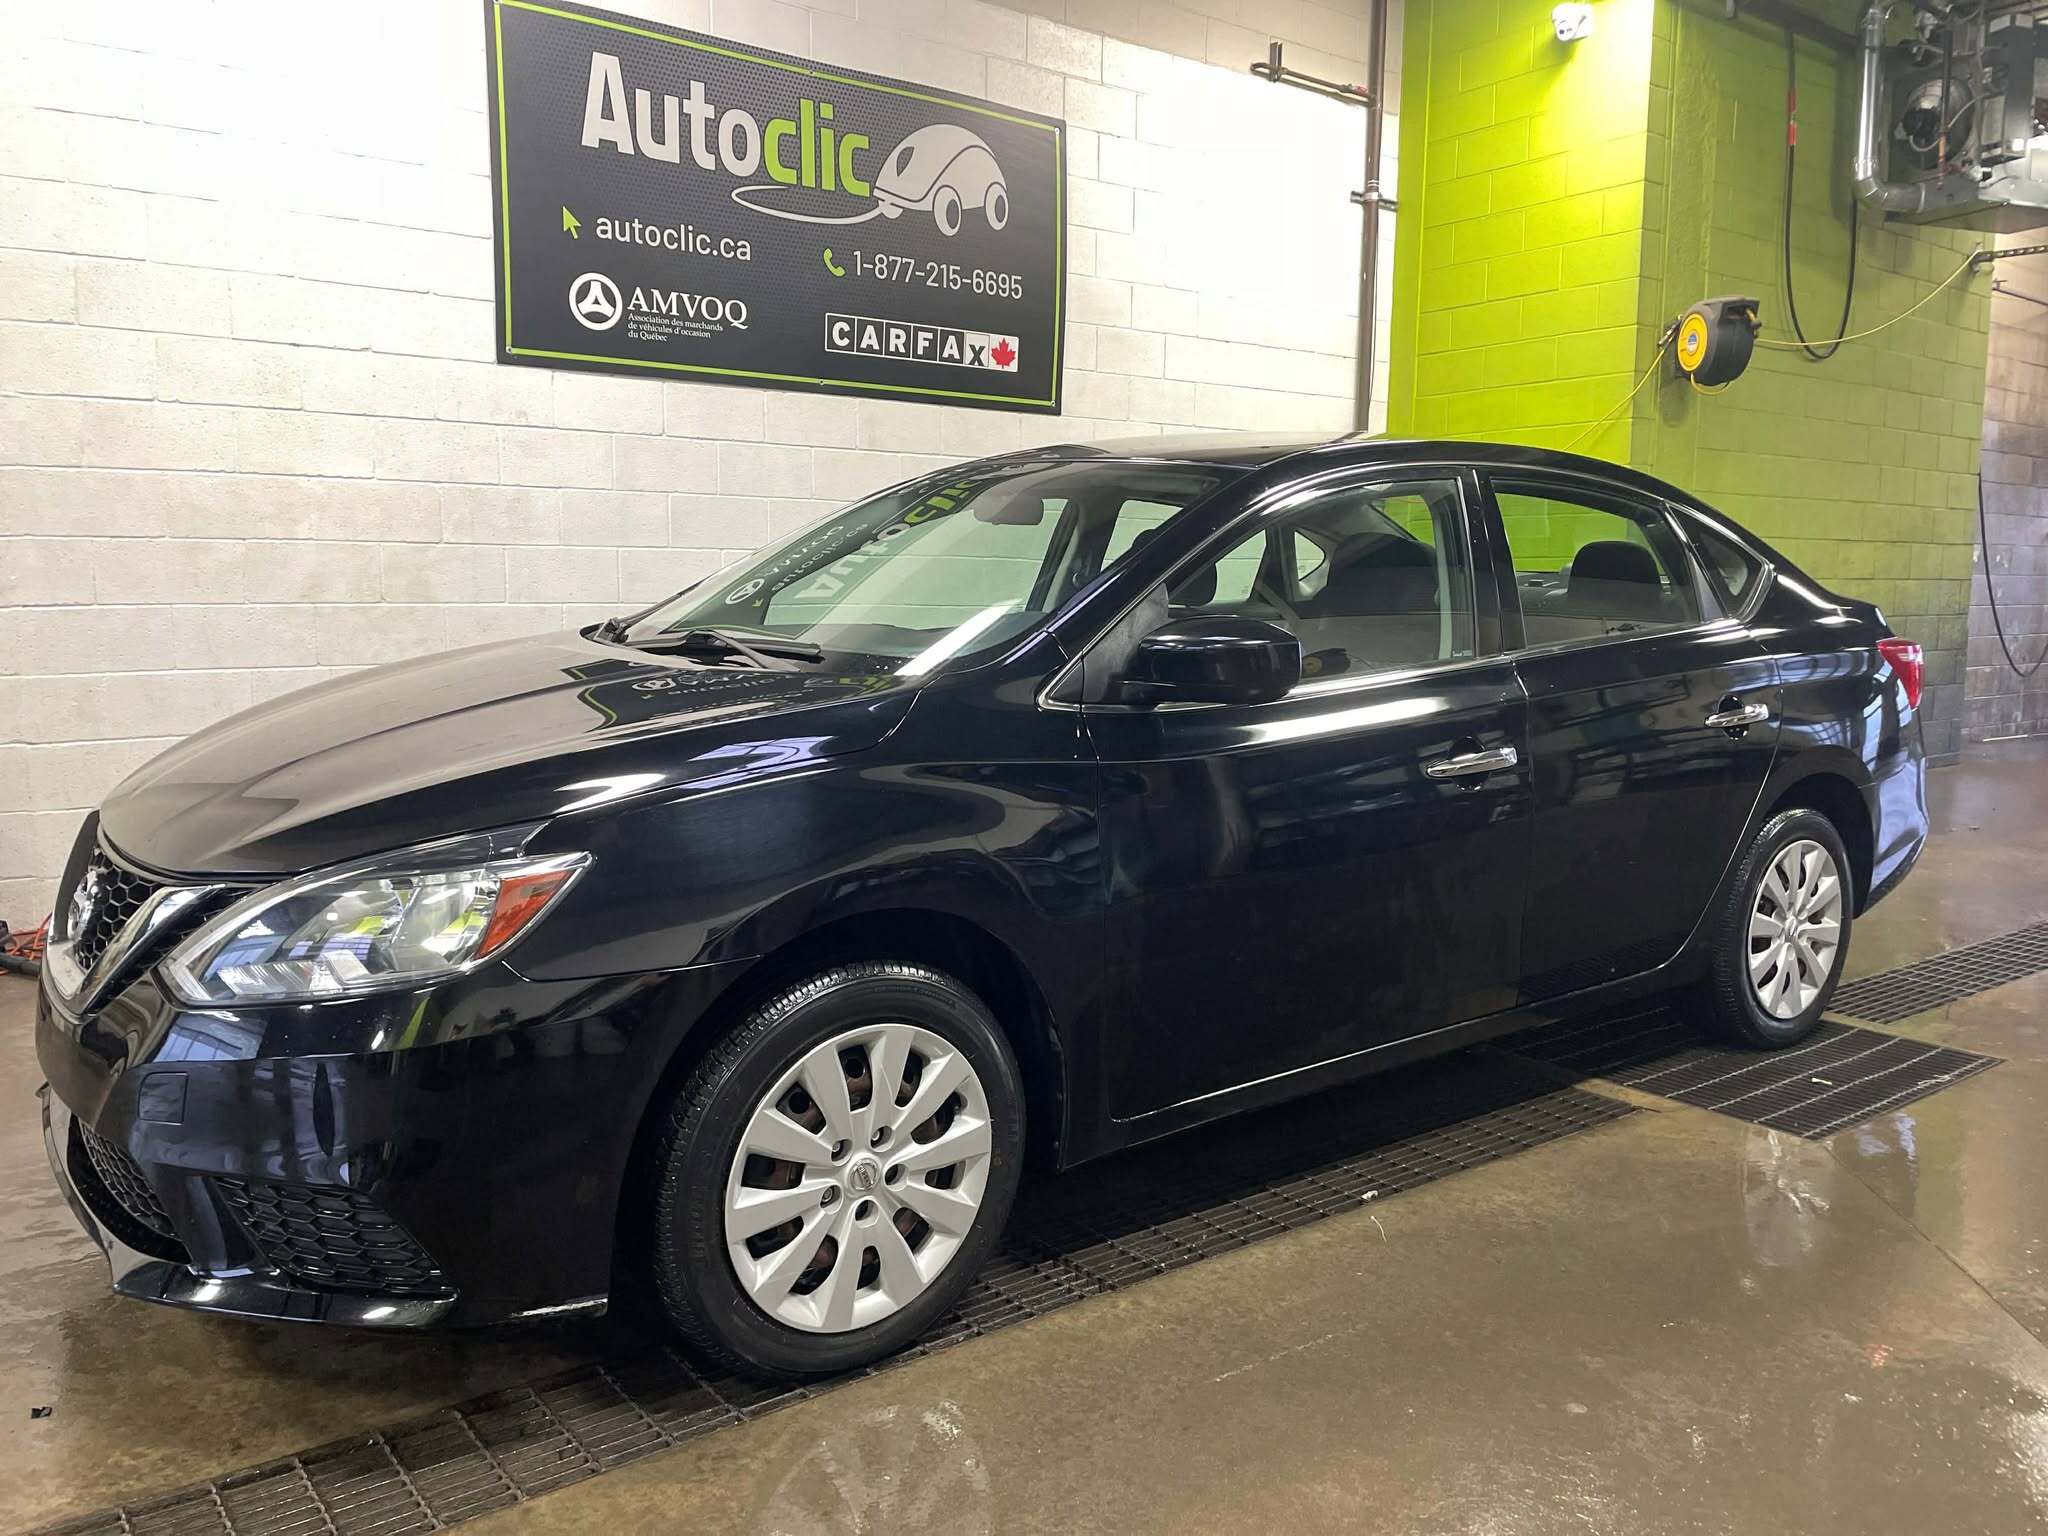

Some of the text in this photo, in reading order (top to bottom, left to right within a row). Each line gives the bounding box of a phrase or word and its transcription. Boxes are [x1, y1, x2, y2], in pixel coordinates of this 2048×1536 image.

[581, 50, 870, 197] Autoclic
[595, 216, 752, 261] autoclic.ca
[853, 250, 1023, 300] 1-877-215-6695
[627, 286, 749, 330] AMVOQ
[627, 321, 711, 338] de véhicules d'occasion
[628, 312, 724, 332] Association des marchands
[627, 330, 668, 342] du Québec
[832, 321, 987, 367] CARFAX
